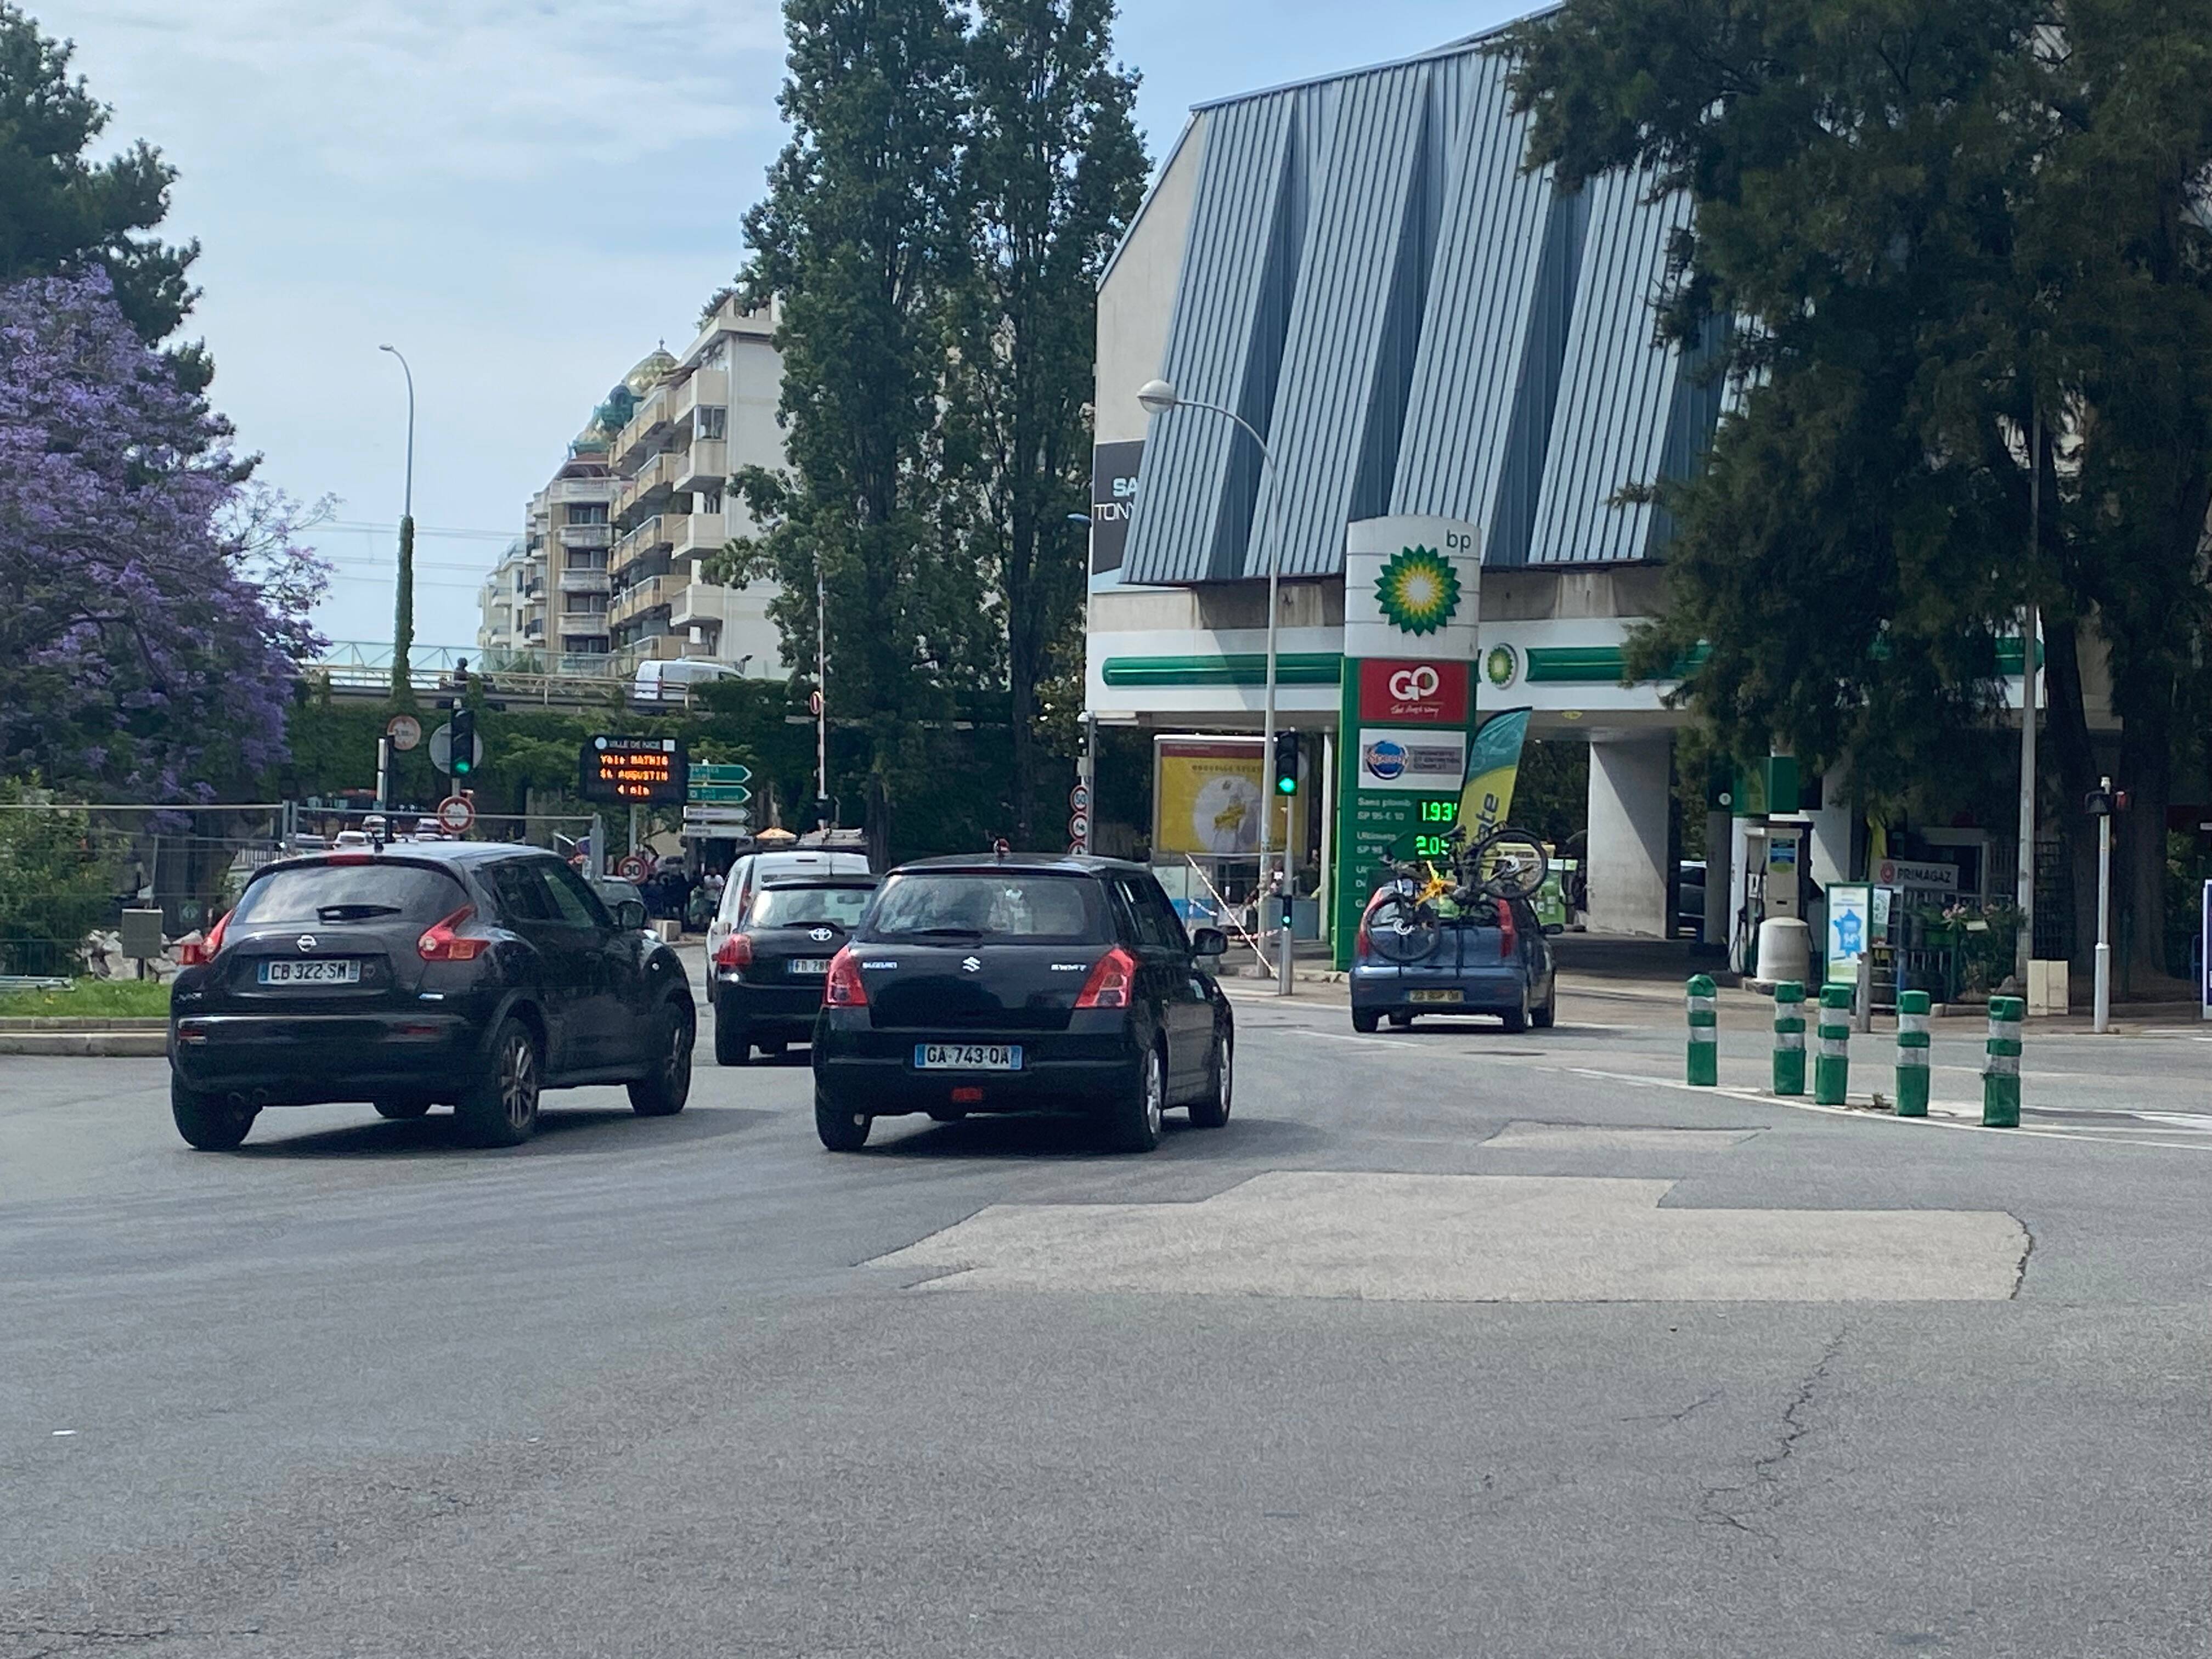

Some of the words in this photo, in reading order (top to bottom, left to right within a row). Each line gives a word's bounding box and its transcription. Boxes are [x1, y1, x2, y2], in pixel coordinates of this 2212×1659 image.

[1446, 529, 1471, 553] bp
[1389, 667, 1439, 701] GO
[617, 785, 624, 795] 4
[627, 864, 641, 876] 30
[1897, 867, 1952, 884] PRIMAGAZ
